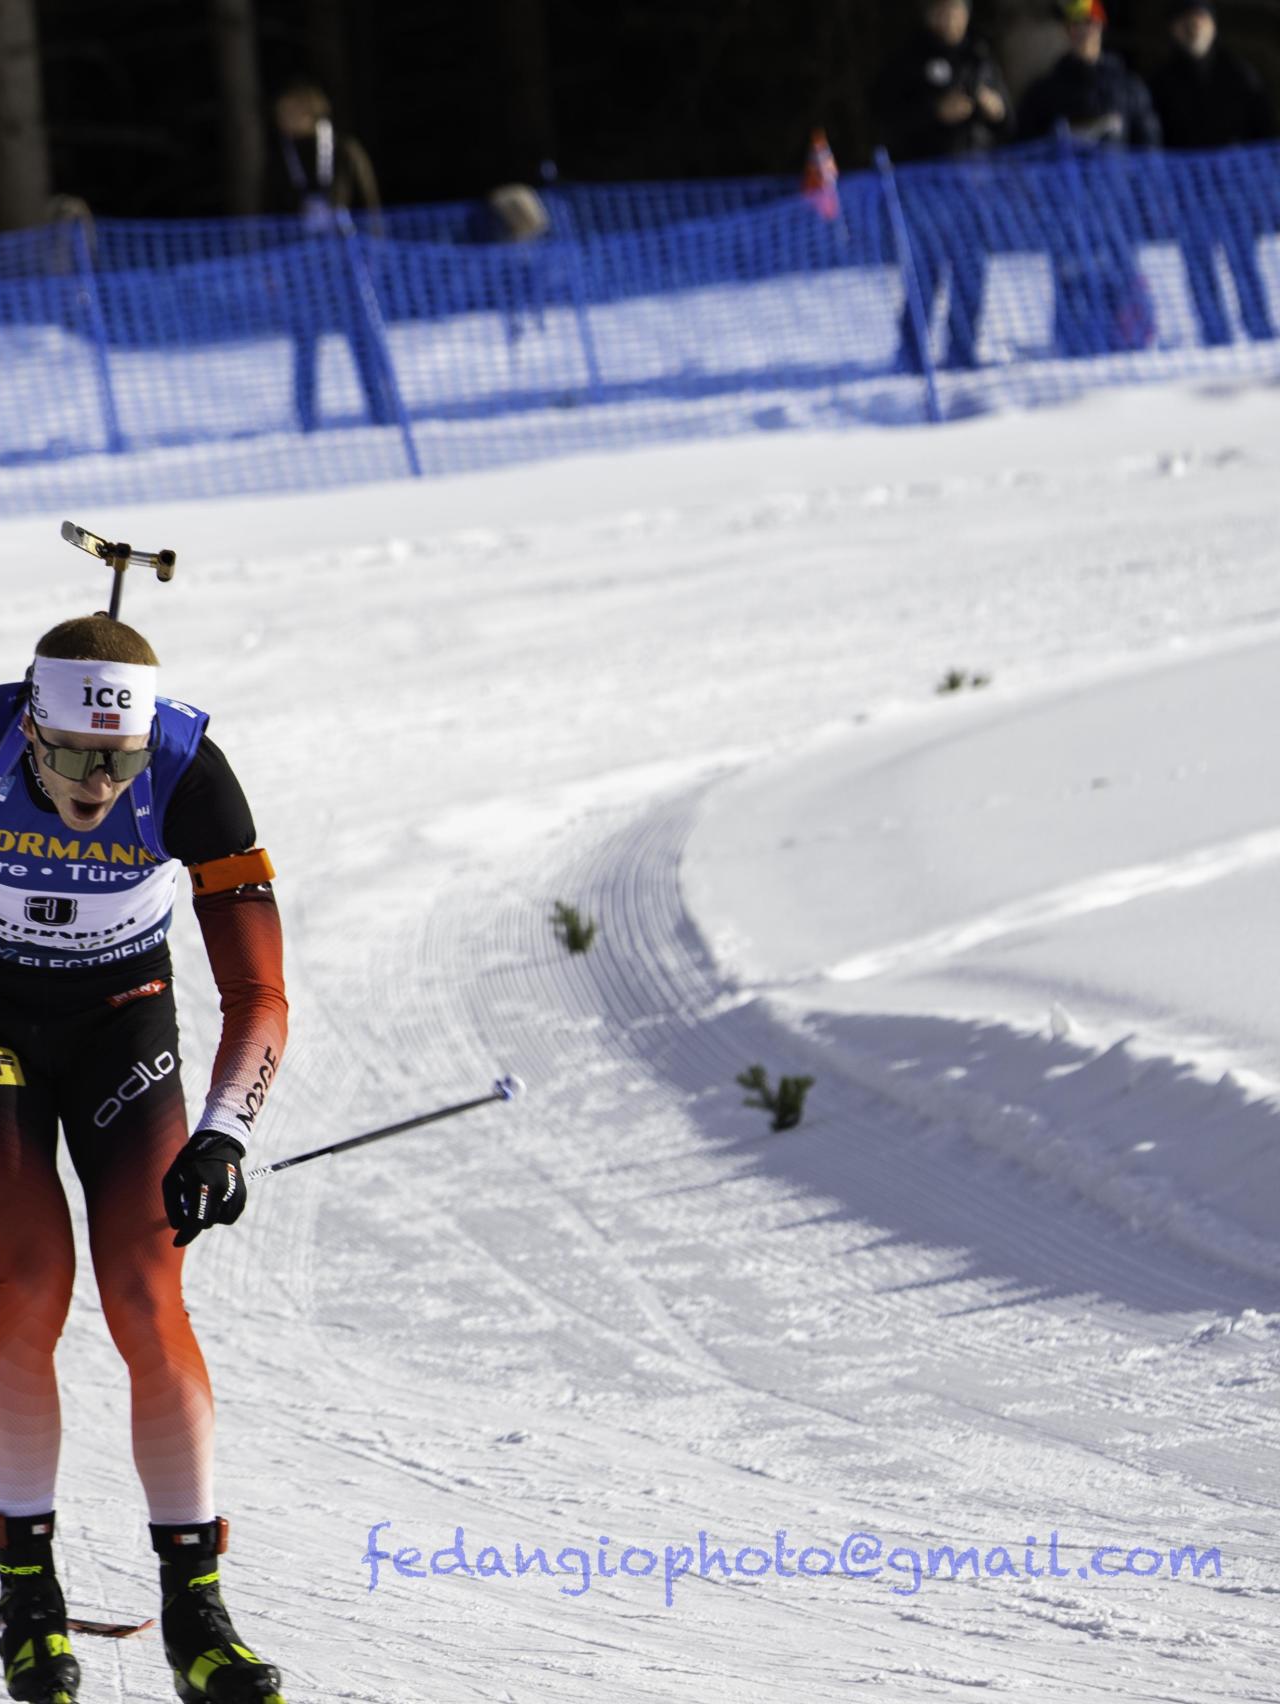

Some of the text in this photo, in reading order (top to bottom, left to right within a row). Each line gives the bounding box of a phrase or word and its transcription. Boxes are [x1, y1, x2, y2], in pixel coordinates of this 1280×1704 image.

[83, 676, 131, 709] ice
[94, 1051, 175, 1127] odlo
[236, 1046, 277, 1132] NORGE
